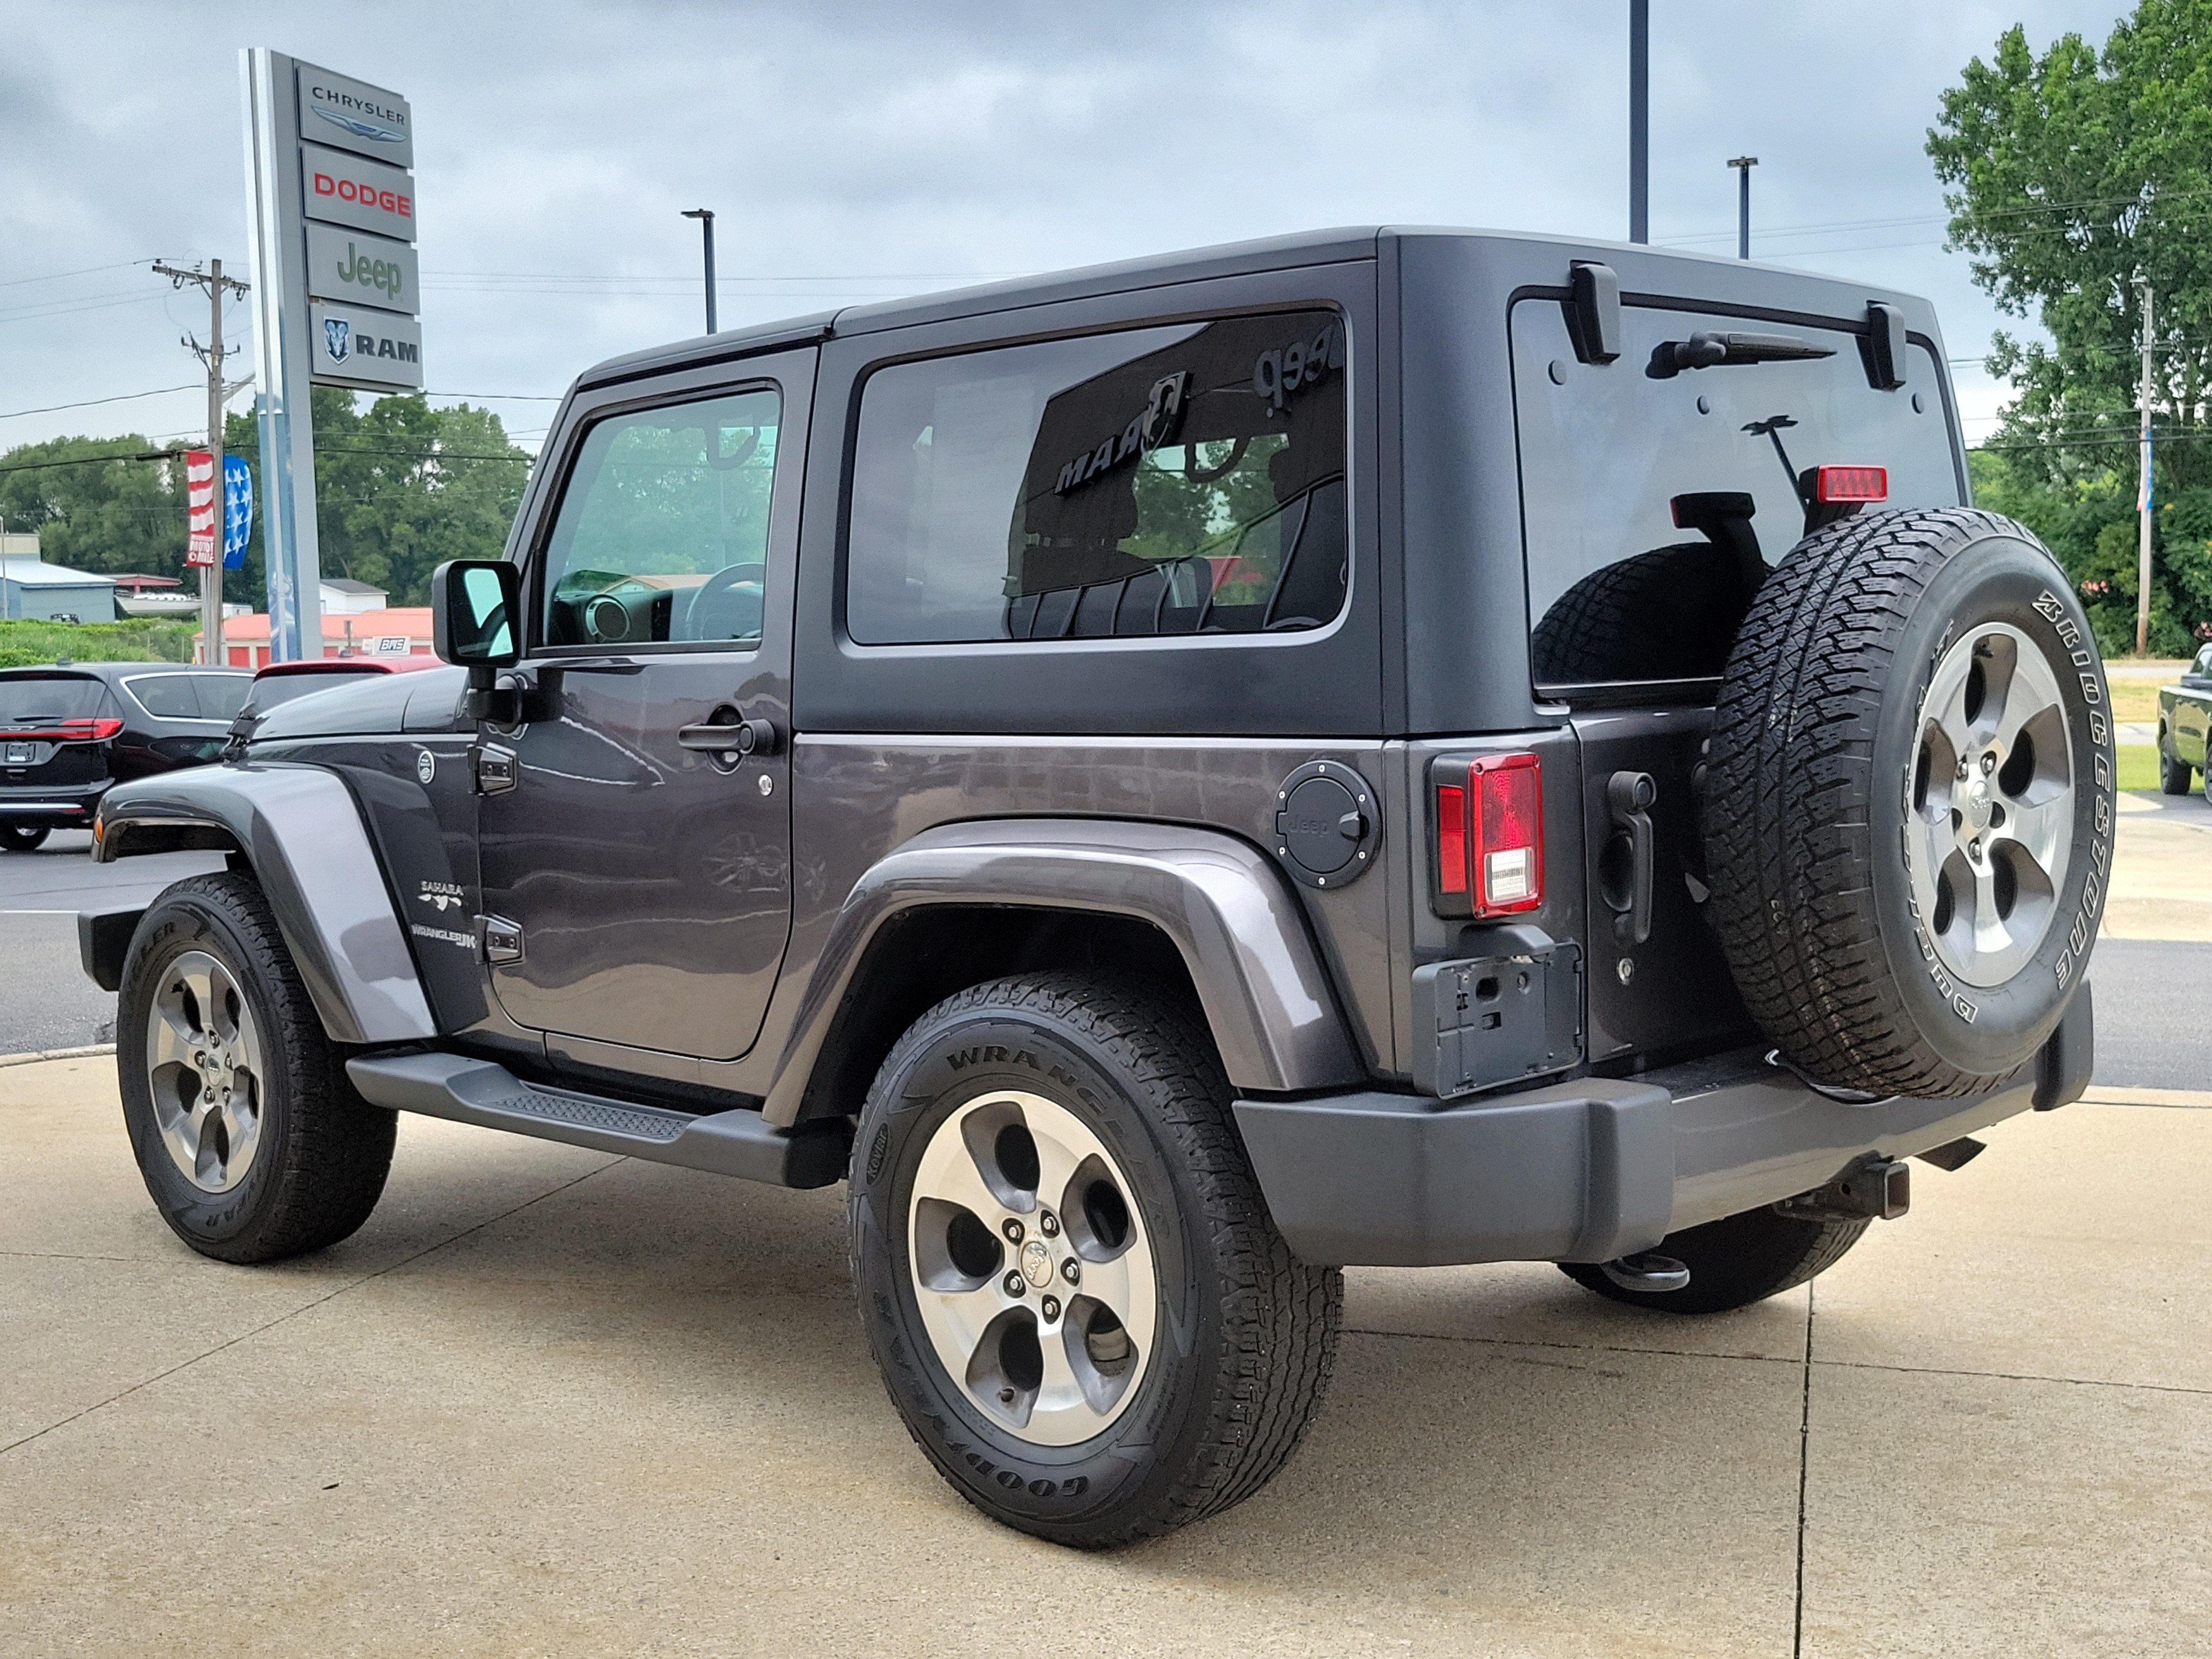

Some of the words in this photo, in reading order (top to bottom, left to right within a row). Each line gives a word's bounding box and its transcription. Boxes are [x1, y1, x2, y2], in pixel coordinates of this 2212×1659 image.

[312, 86, 405, 126] CHRYSLER
[314, 172, 411, 218] DODGE
[337, 242, 402, 300] Jeep
[356, 333, 418, 364] RAM
[2032, 589, 2109, 990] BRIDGESTONE
[421, 881, 464, 895] SAHARA
